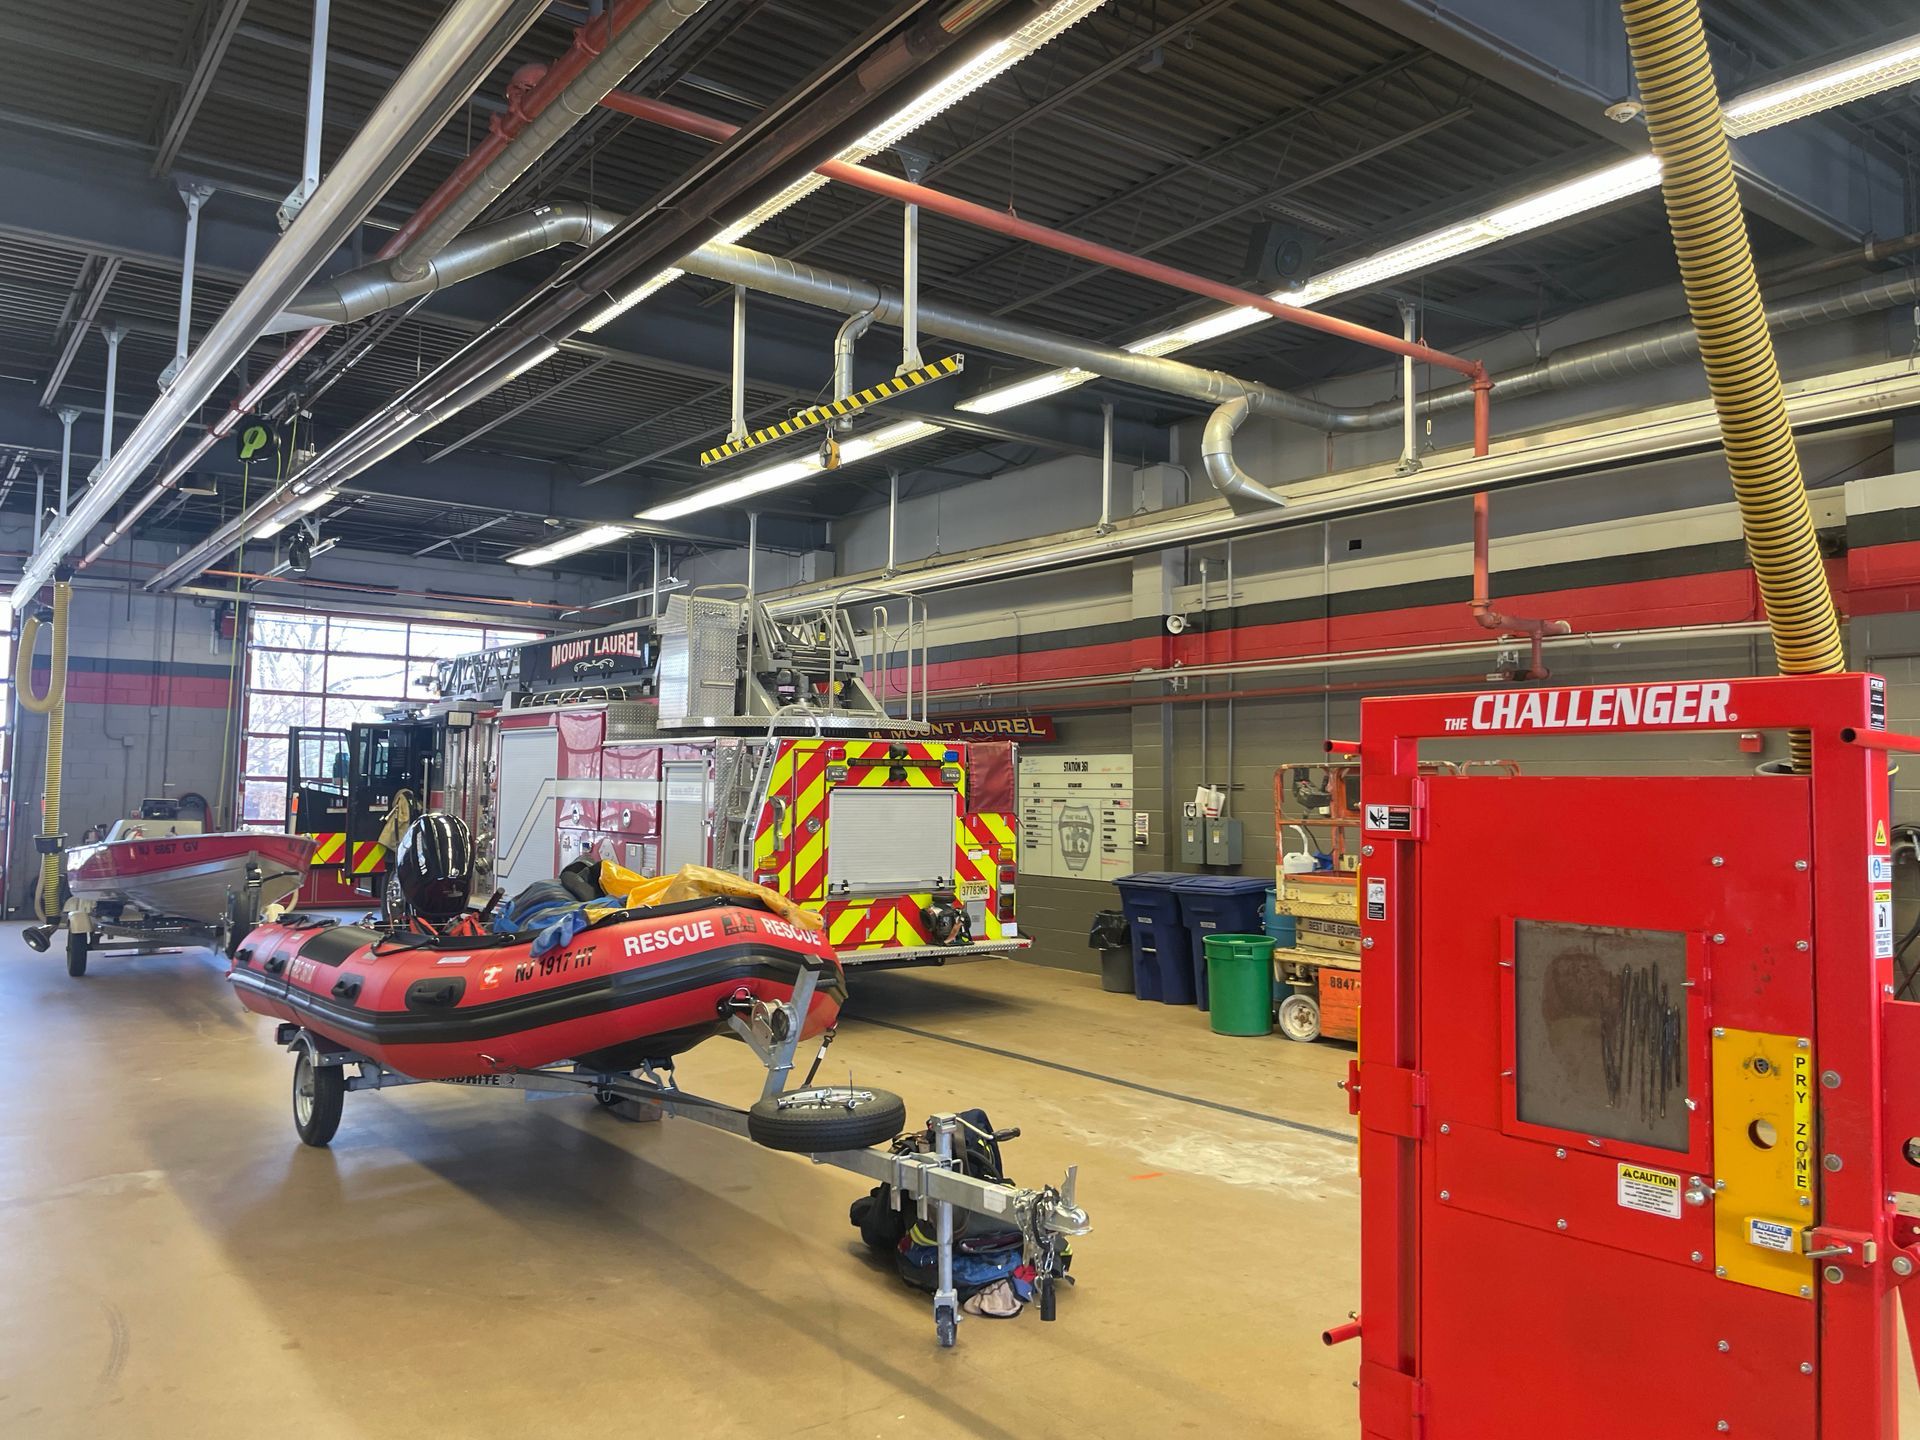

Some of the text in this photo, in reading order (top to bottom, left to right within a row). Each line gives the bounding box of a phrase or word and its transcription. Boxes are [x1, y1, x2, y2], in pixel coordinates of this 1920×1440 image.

[551, 632, 641, 669] MOUNT LAUREL
[1444, 683, 1731, 731] THE CHALLENGER
[960, 718, 1046, 736] LAUREL
[1063, 761, 1081, 772] STATION
[623, 920, 715, 957] RESCUE
[760, 917, 822, 946] RESCUE
[1309, 921, 1322, 931] BEST
[1324, 923, 1337, 934] LINE
[514, 947, 597, 983] NJ 1917 HT
[1795, 1057, 1807, 1104] PRY
[1795, 1122, 1808, 1188] ZONE
[1632, 1170, 1677, 1187] CAUTION
[1756, 1222, 1787, 1235] NOTICE
